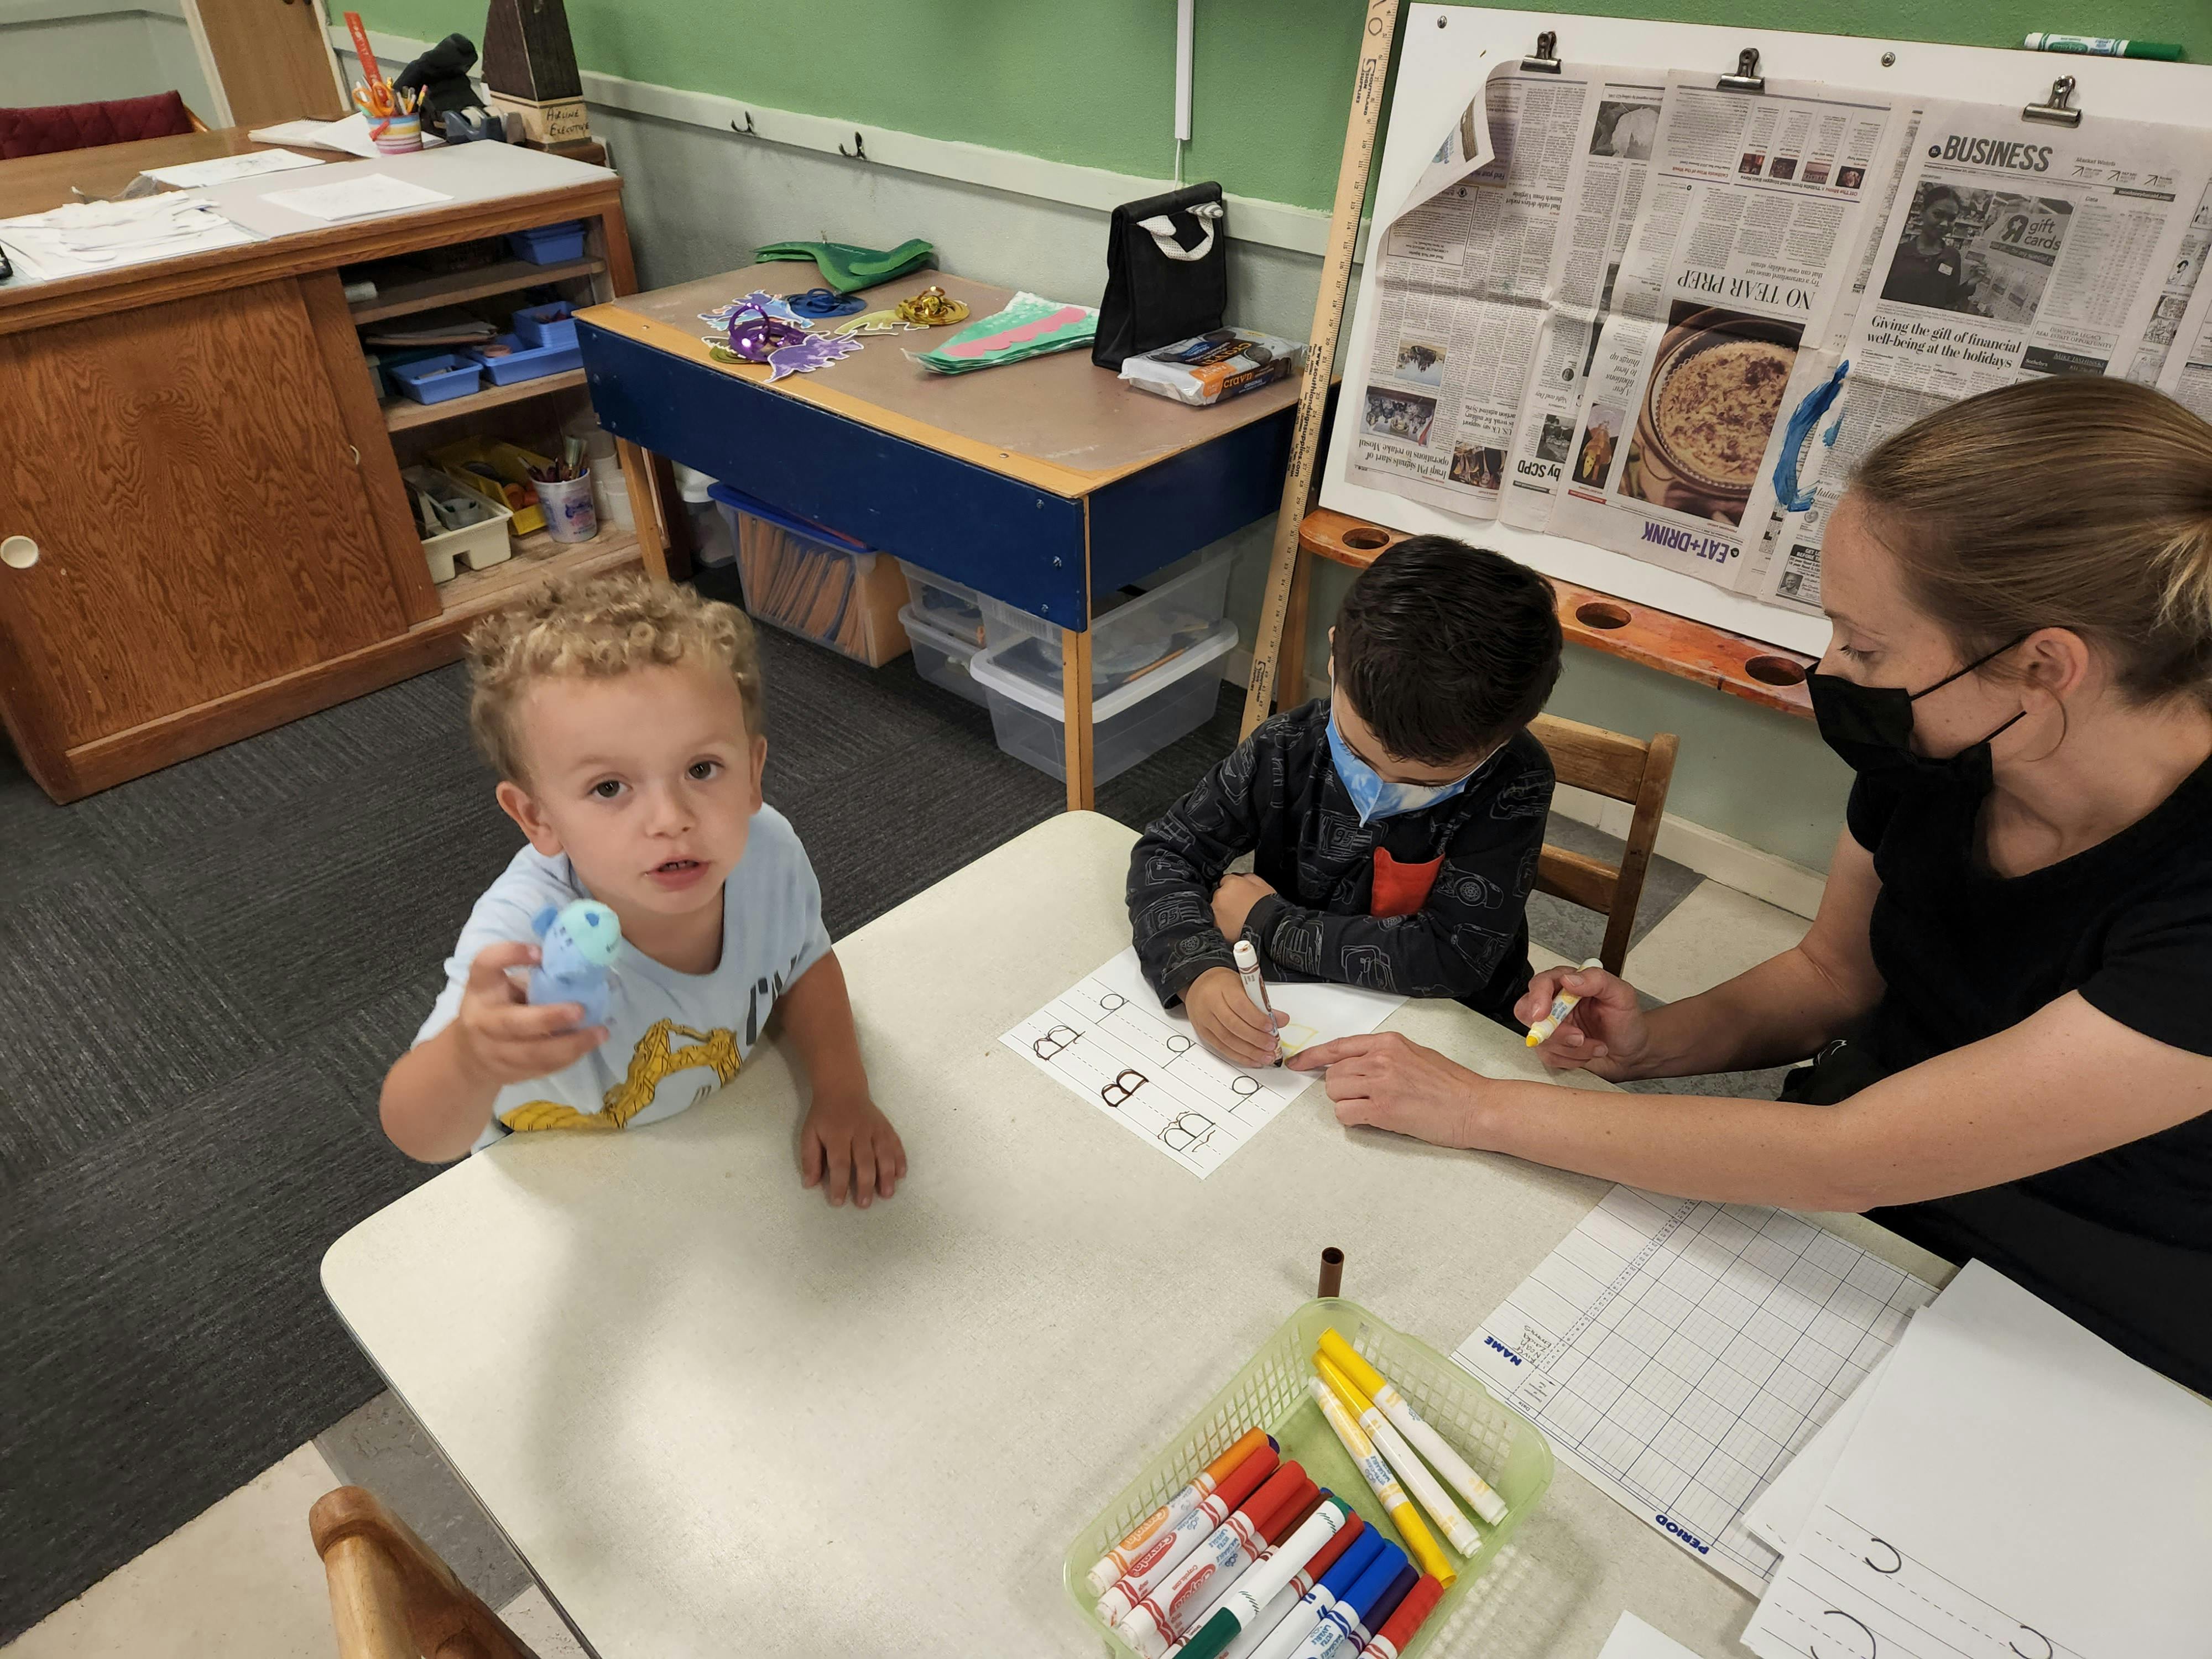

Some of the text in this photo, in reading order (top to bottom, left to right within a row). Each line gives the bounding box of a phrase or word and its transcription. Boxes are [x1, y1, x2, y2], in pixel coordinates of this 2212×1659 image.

[1355, 71, 1364, 103] SUPPLIES
[1363, 72, 1374, 116] SOUTHLAND
[1942, 133, 2053, 174] BUSINESS
[1512, 189, 1531, 199] Virginia
[1521, 199, 1536, 208] delays
[1545, 195, 1562, 204] launch
[2029, 215, 2056, 238] gift
[2024, 229, 2062, 251] cards
[1767, 263, 1786, 273] holiday
[1771, 272, 1804, 284] caramelized
[1810, 279, 1819, 287] Try
[1677, 268, 1815, 310] NO TEAR PREP
[1870, 314, 1910, 336] Giving
[1911, 322, 1931, 337] the
[1931, 325, 1952, 344] gift
[1953, 330, 1968, 343] of
[1968, 332, 2021, 354] financial
[2049, 326, 2101, 340] DISCOVER LEGACY
[2070, 336, 2112, 349] OPPORTUNITY
[1609, 351, 1640, 367] things up
[1866, 329, 2013, 372] well-being at the holidays
[1613, 364, 1627, 374] heat
[1605, 373, 1635, 385] libations
[1534, 390, 1543, 398] Day
[1554, 394, 1567, 403] Night
[1612, 385, 1624, 394] few
[1293, 345, 1323, 478] www.southlandsignsupplies.com
[1464, 403, 1516, 421] action against Syria
[1464, 409, 1484, 422] military
[1462, 418, 1481, 429] support
[1492, 418, 1507, 427] weak
[1358, 438, 1449, 467] operations to retake Mosul
[1365, 451, 1447, 479] Iraqi PM signals start of
[1516, 459, 1561, 482] by SCPD
[1641, 519, 1729, 565] EAT+DRINK
[1796, 551, 1814, 560] BEFORE
[1334, 827, 1354, 846] 95
[1159, 907, 1180, 925] 95
[1033, 1024, 1217, 1151] B B B
[1483, 1335, 1522, 1366] NAME
[1519, 1339, 1541, 1358] Noah
[1517, 1400, 1530, 1411] Date
[1123, 1509, 1168, 1547] Crayola
[1206, 1527, 1229, 1548] LAVABLE
[1653, 1513, 1710, 1554] PERIOD
[1212, 1537, 1241, 1562] WASHABLE
[1215, 1536, 1231, 1550] ULTRA
[1130, 1535, 1176, 1574] Crayola
[1168, 1564, 1200, 1590] Crayola.com
[1167, 1567, 1218, 1611] Crayola
[1187, 1623, 1202, 1637] brown
[1308, 1623, 1333, 1645] LAVABLE
[1318, 1632, 1335, 1647] ULTRA
